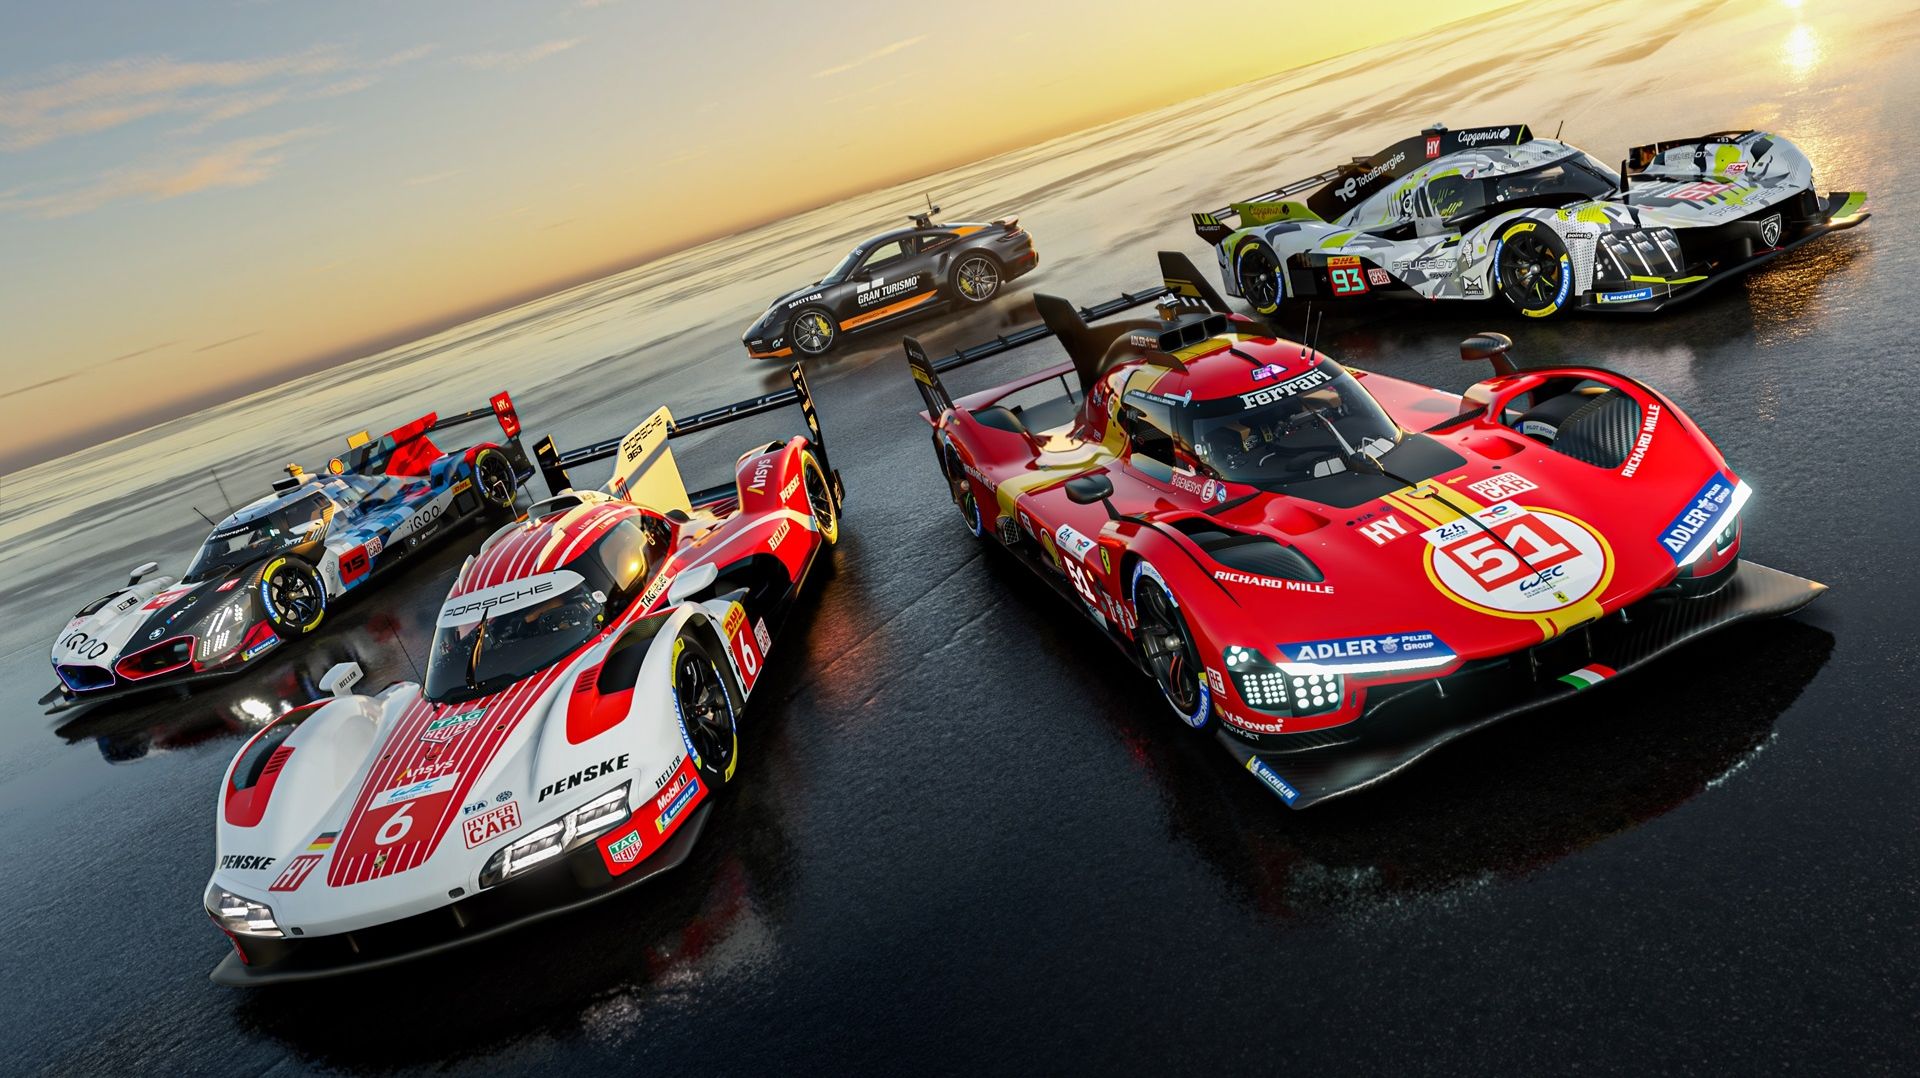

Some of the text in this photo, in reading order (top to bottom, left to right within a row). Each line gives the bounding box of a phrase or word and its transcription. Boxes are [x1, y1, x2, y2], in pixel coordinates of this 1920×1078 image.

[1427, 140, 1440, 155] HY
[1458, 129, 1500, 146] Capgemini
[1356, 151, 1405, 187] TotalEnergies
[1333, 257, 1355, 265] DHL
[1392, 258, 1457, 271] PEUGEOT
[1332, 268, 1365, 293] 93
[1369, 269, 1386, 277] HYPER
[1371, 276, 1390, 285] CAR
[858, 276, 918, 305] GRAN TURISMO
[1556, 270, 1571, 304] MICHELIN
[1610, 291, 1646, 300] MICHELIN
[788, 293, 822, 309] SAFETY CAR
[1240, 367, 1332, 410] Ferrari
[623, 415, 662, 452] PORSCHE
[1621, 403, 1661, 478] RICHARD MILLE
[627, 445, 643, 462] 963
[454, 482, 471, 494] DHL
[747, 459, 773, 495] Ansys
[1177, 474, 1202, 495] GENESYS
[1473, 473, 1518, 492] HYPER
[779, 474, 800, 503] PENSKE
[1483, 479, 1531, 500] CAR
[1705, 484, 1722, 500] PELZER
[408, 505, 439, 532] iQOO
[1359, 515, 1408, 545] HY
[1663, 508, 1711, 553] ADLER
[369, 543, 382, 556] CAR
[1452, 523, 1571, 583] 51
[343, 554, 366, 573] 15
[1064, 556, 1096, 603] 51
[1214, 570, 1334, 594] RICHARD MILLE
[1520, 565, 1564, 591] WEC
[444, 581, 554, 618] PORSCHE
[725, 607, 742, 636] DHL
[60, 629, 108, 660] iQOO
[254, 638, 276, 652] MICHELIN
[1401, 633, 1432, 643] PELZER
[1403, 641, 1434, 650] GROUP
[739, 630, 756, 676] 6
[1296, 639, 1378, 661] ADLER
[339, 671, 357, 688] HELLER
[434, 710, 482, 727] TAG
[1224, 710, 1284, 732] V-Power
[424, 720, 477, 741] HEUER
[397, 759, 454, 781] Ansys
[538, 753, 629, 803] PENSKE
[655, 756, 681, 789] HELLER
[391, 778, 440, 798] WEC
[1259, 768, 1295, 799] MICHELIN
[657, 782, 679, 811] Mobil
[669, 786, 694, 817] MICHELIN
[464, 803, 487, 815] FIA
[467, 805, 514, 831] HYPER
[375, 802, 416, 846] 6
[469, 815, 517, 844] CAR
[613, 832, 637, 851] TAG
[614, 842, 641, 862] HEUER
[220, 854, 276, 870] PENSKE
[273, 858, 317, 888] HY
